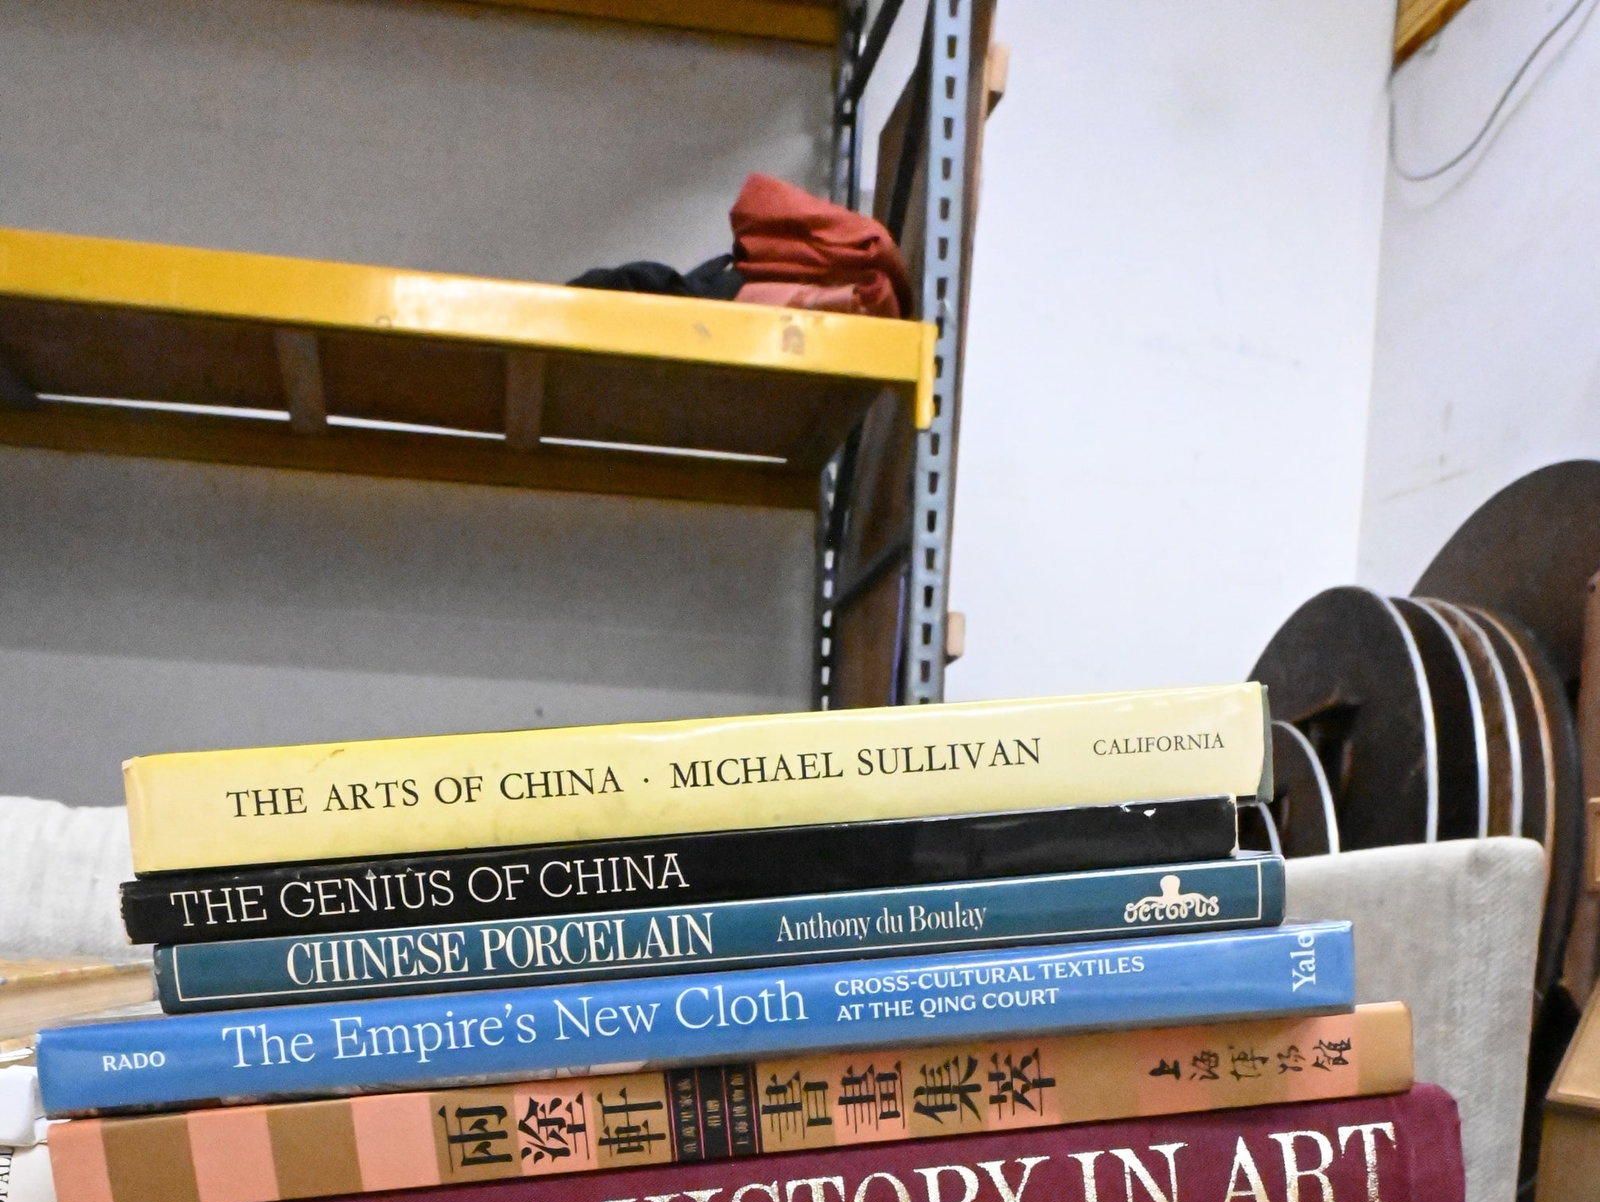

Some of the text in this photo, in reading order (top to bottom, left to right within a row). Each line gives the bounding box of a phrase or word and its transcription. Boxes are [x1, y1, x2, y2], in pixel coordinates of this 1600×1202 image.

[226, 732, 1225, 818] THE ARTS OF CHINA MICHAEL SULLIVAN CALIFORNIA
[170, 852, 690, 927] THE GENIUS OF CHINA
[286, 902, 987, 986] CHINESE PORCELAIN Anthony du Boulay
[834, 955, 1146, 998] CROSS-CULTURAL TEXTILES
[1289, 931, 1317, 993] Yale
[102, 978, 810, 1072] RADO The Empire's New Cloth
[835, 986, 1059, 1023] AT THE QING COURT
